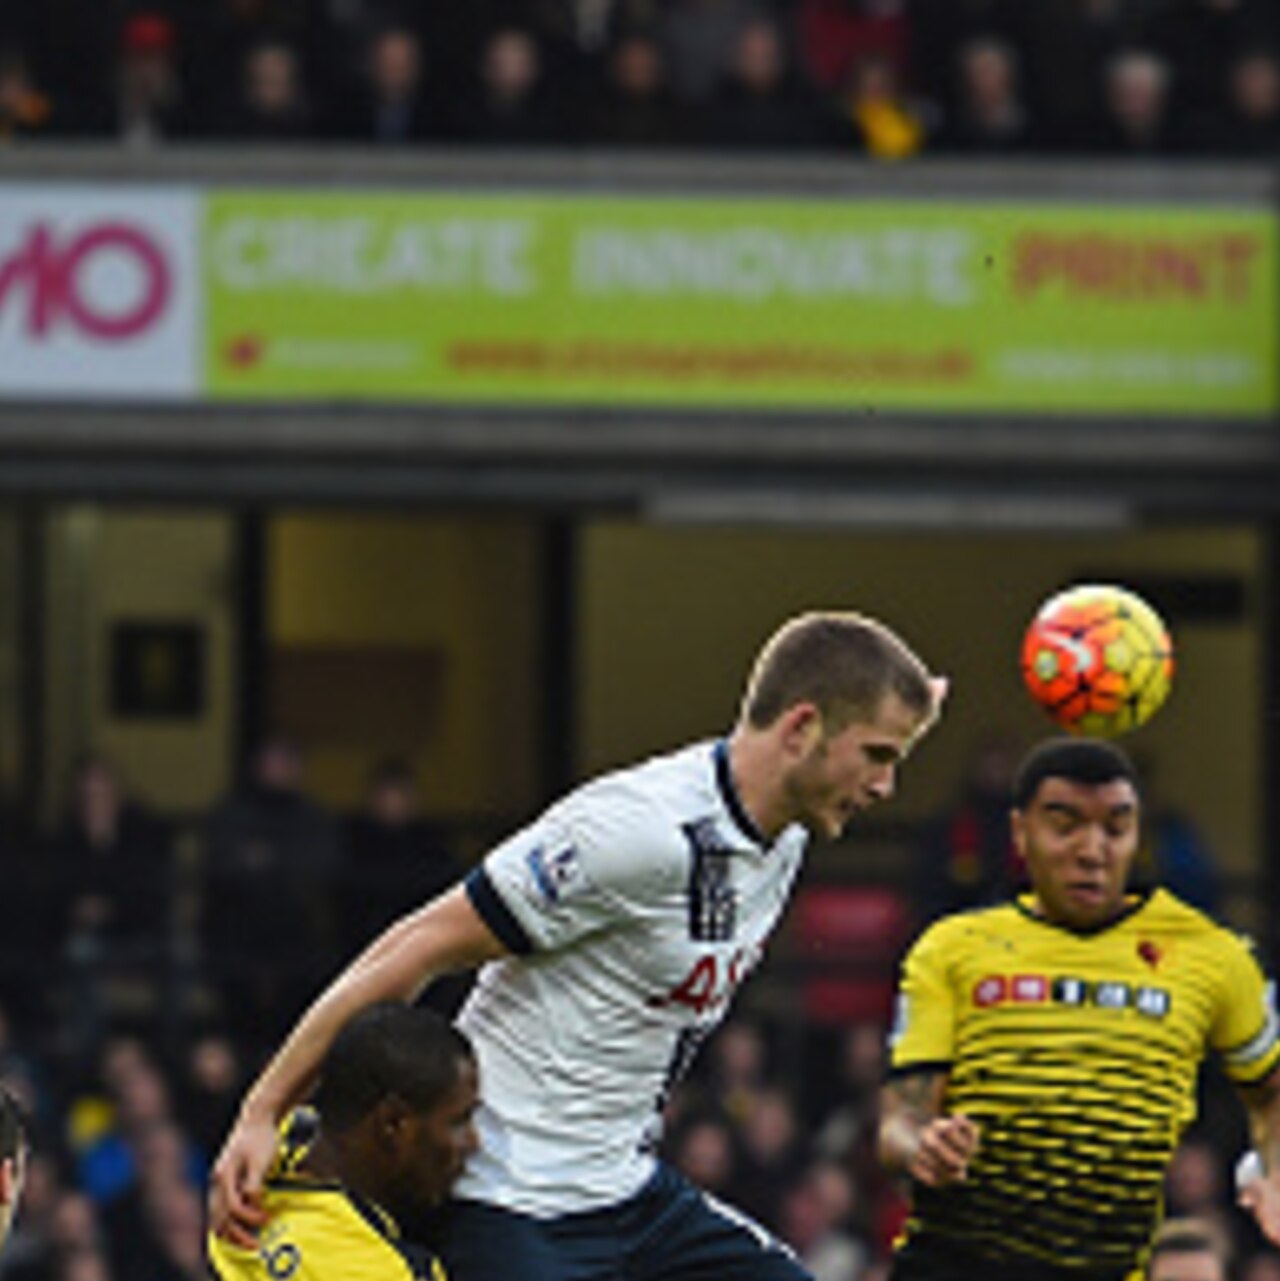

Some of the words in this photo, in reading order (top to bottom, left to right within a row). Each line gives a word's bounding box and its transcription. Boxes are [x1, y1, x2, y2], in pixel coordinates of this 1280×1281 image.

[213, 214, 539, 298] CREATE
[572, 221, 983, 310] INNOVATE
[1006, 228, 1263, 306] PRINT
